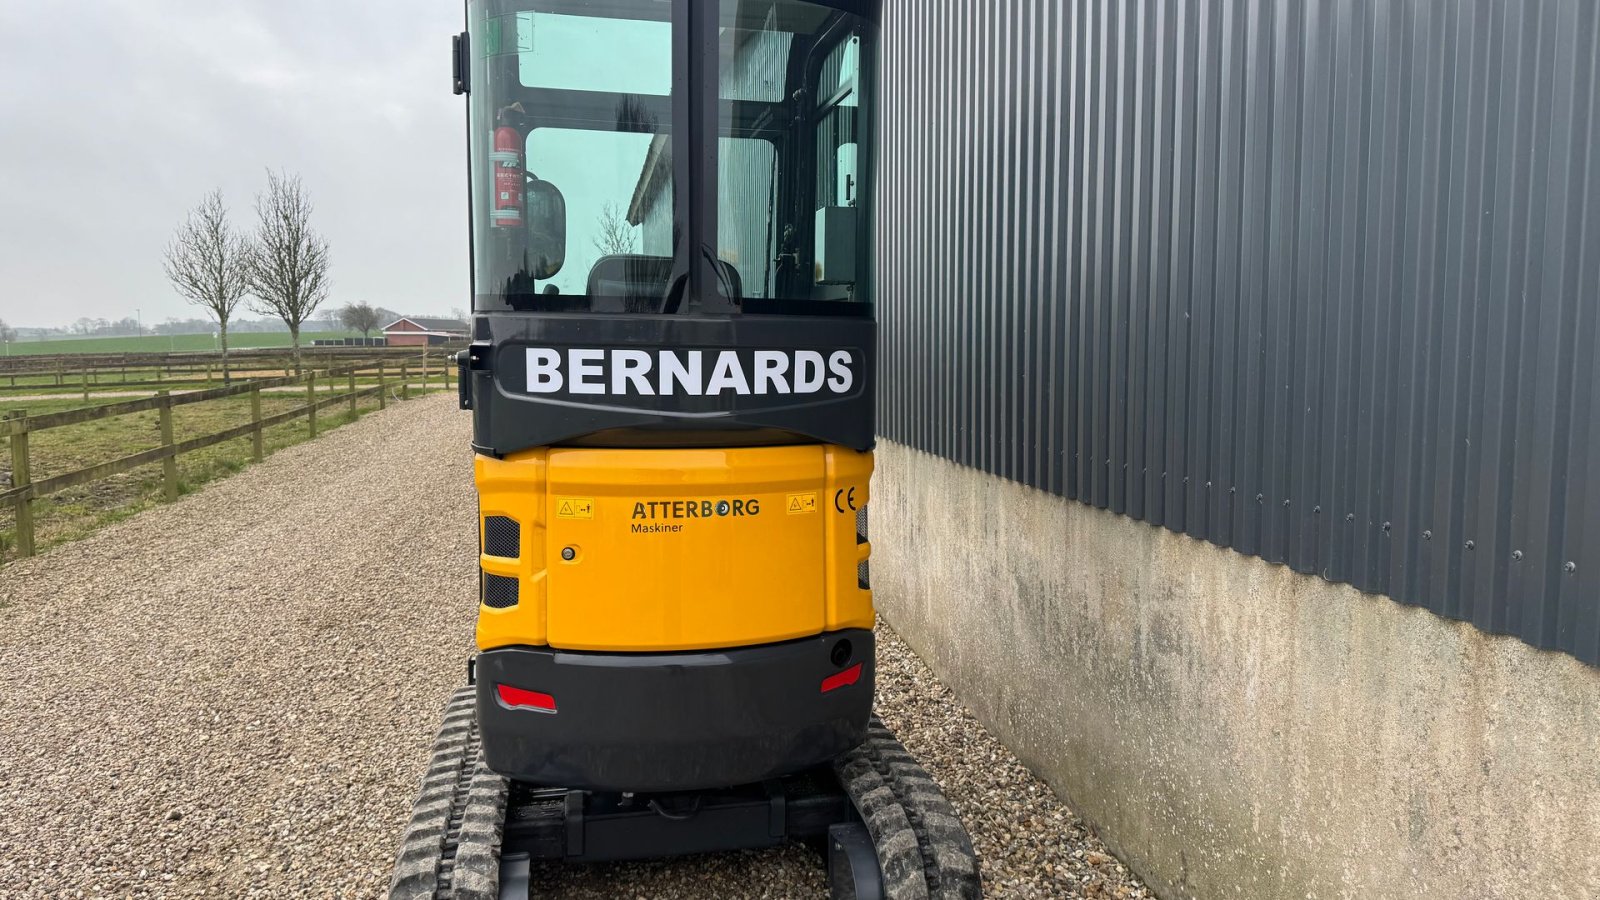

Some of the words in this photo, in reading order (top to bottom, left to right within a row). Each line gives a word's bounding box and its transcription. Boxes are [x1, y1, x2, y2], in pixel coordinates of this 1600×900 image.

[525, 347, 853, 395] BERNARDS
[631, 499, 760, 519] ATTERBORG
[834, 486, 856, 514] CE
[631, 522, 683, 533] Maskiner
